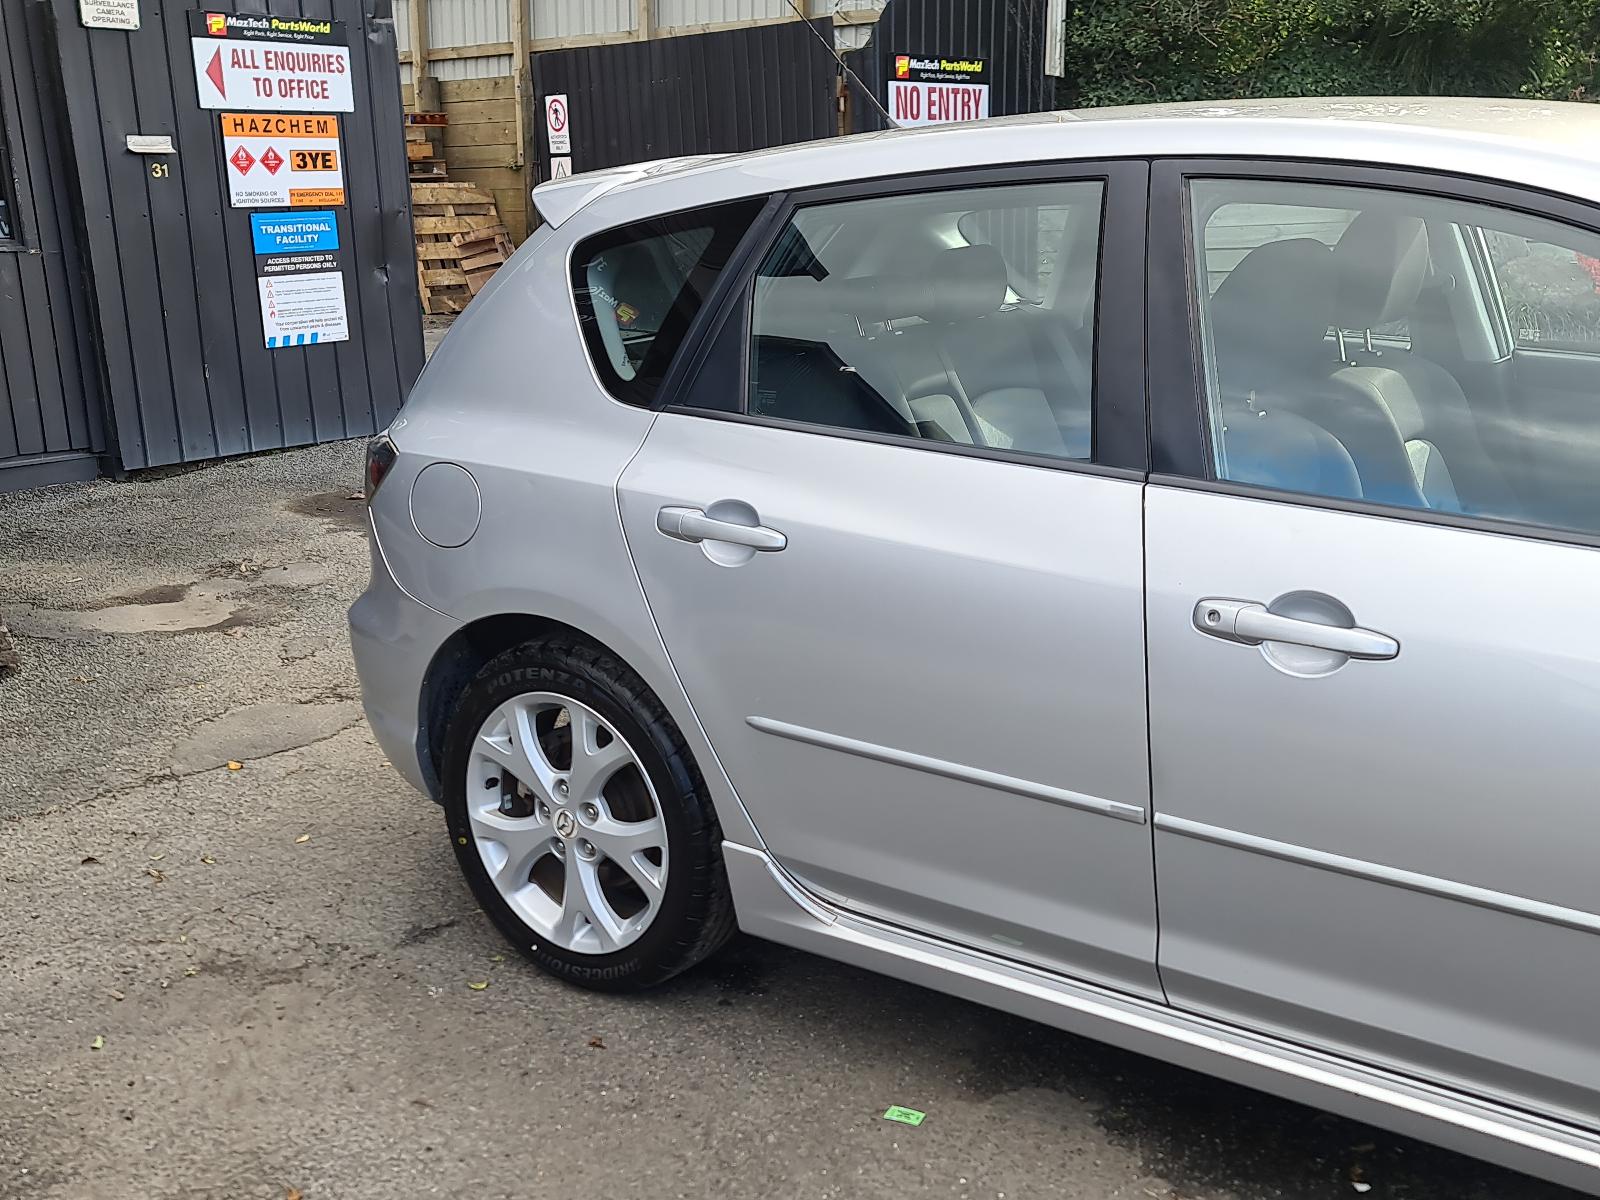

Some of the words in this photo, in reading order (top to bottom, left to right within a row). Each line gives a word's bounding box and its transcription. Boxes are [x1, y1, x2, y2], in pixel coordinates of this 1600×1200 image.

[84, 0, 135, 9] SURVEILLANCE
[96, 7, 126, 16] CAMERA
[91, 15, 131, 25] OPERATING
[227, 16, 270, 29] MazTech
[271, 18, 331, 34] PartsWorld
[231, 48, 260, 69] ALL
[264, 50, 345, 75] ENQUIRIES
[909, 58, 940, 70] MazTech
[940, 59, 983, 72] PartsWorld
[252, 77, 273, 98] TO
[278, 78, 330, 100] OFFICE
[895, 85, 921, 121] NO
[927, 86, 983, 121] ENTRY
[233, 117, 329, 134] HAZCHEM
[295, 152, 333, 169] 3YE
[151, 162, 169, 178] 31
[260, 222, 332, 234] TRANSITIONAL
[275, 234, 319, 245] FACILITY
[263, 264, 296, 273] PERMITTED
[296, 262, 322, 271] PERSONS
[266, 257, 291, 265] ACCESS
[290, 255, 325, 263] RESTRICTED
[487, 667, 586, 695] POTENZA
